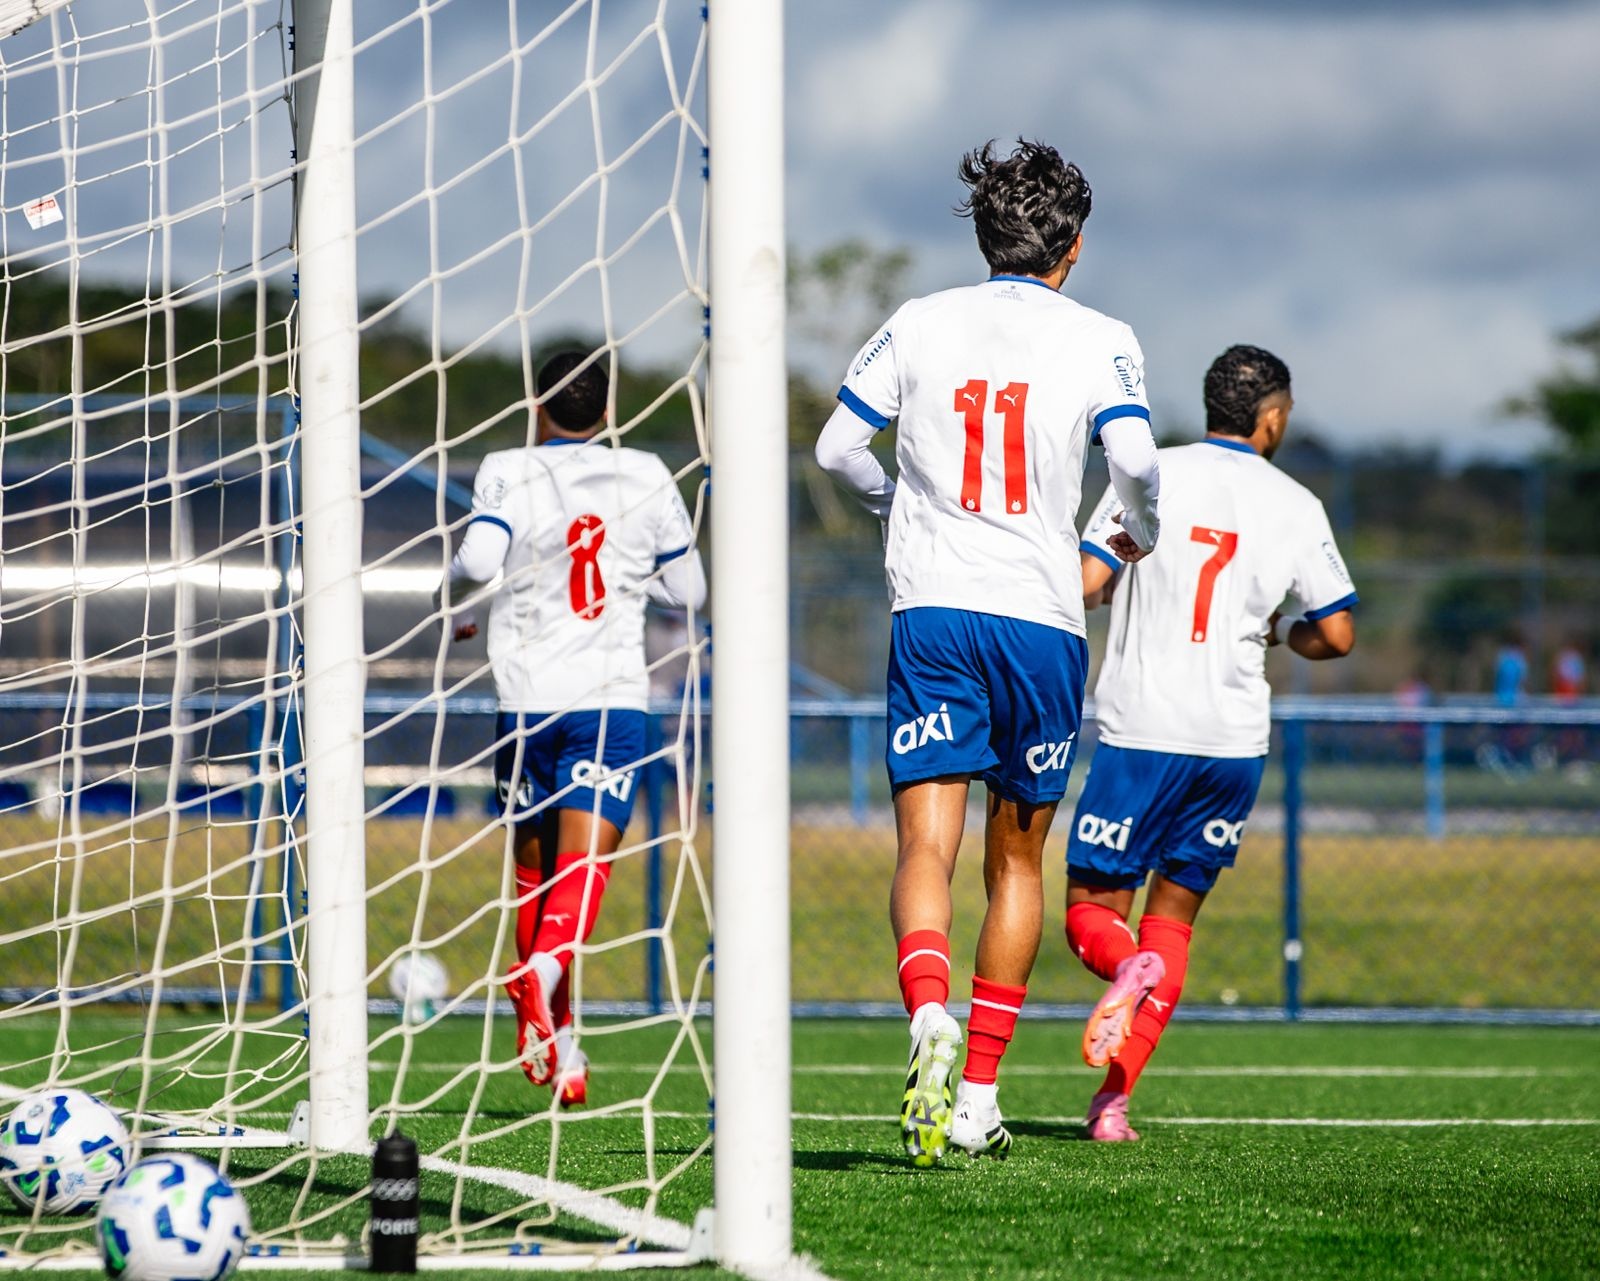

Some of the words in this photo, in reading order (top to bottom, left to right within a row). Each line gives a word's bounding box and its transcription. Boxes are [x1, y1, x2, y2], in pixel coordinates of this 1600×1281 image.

[954, 379, 1029, 515] 11
[567, 514, 606, 621] 8
[1190, 526, 1238, 643] 7
[893, 702, 954, 755] axi
[571, 759, 635, 802] axi
[1077, 813, 1133, 851] axi
[1203, 818, 1246, 848] ax
